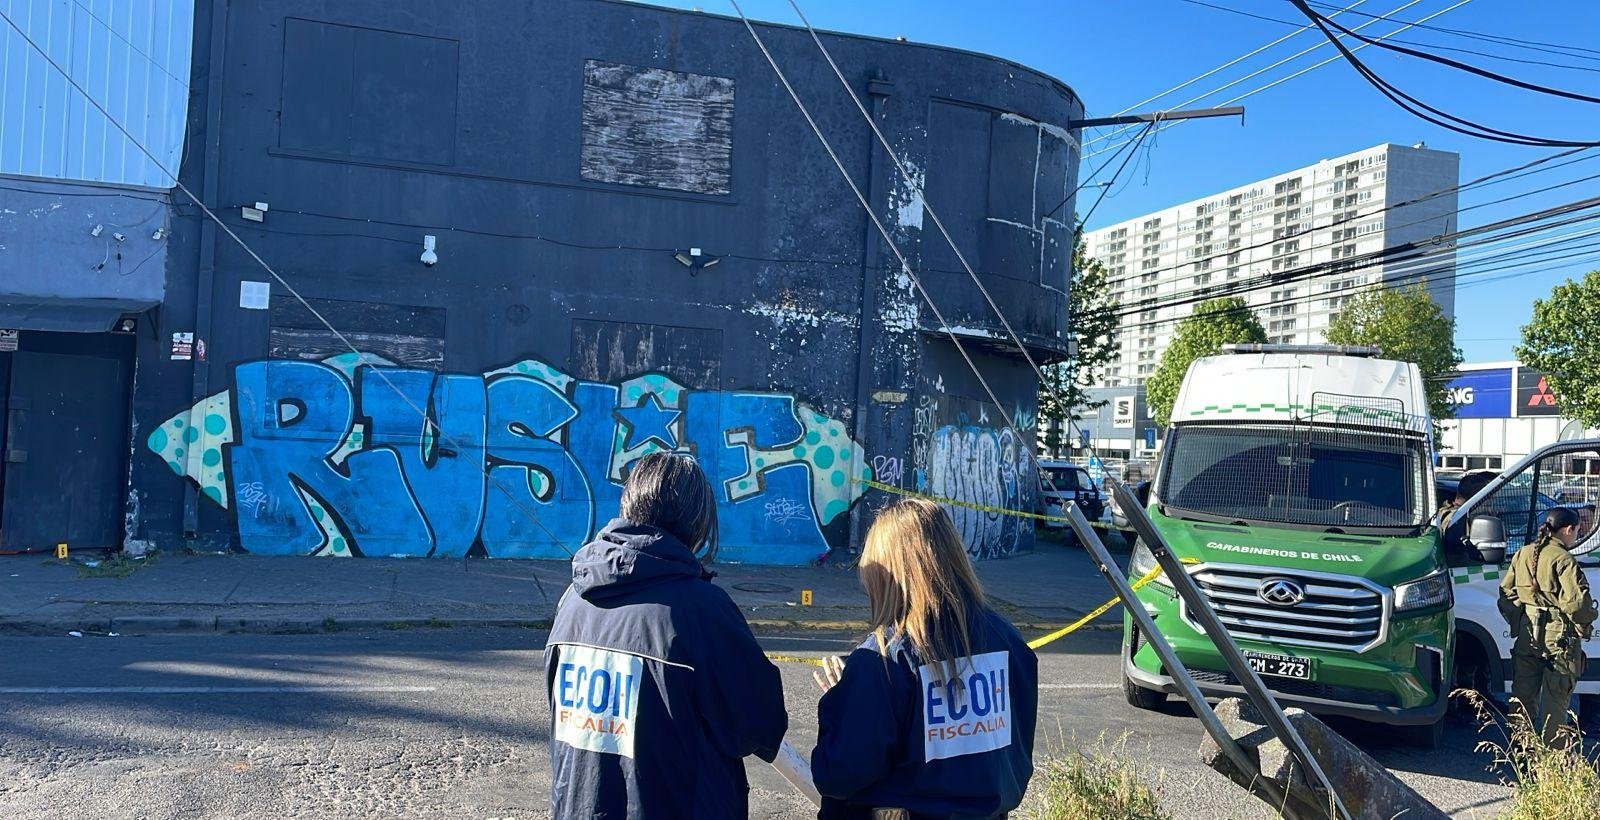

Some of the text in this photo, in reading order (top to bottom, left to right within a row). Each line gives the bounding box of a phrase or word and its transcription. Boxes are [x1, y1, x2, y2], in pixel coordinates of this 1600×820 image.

[1206, 541, 1364, 563] CARABINEROS DE CHILE
[1277, 661, 1305, 677] 273
[560, 663, 633, 720] ECOH
[927, 669, 1006, 725] ECOH
[560, 710, 628, 736] FICALIA
[928, 716, 1006, 742] FISCALIA
